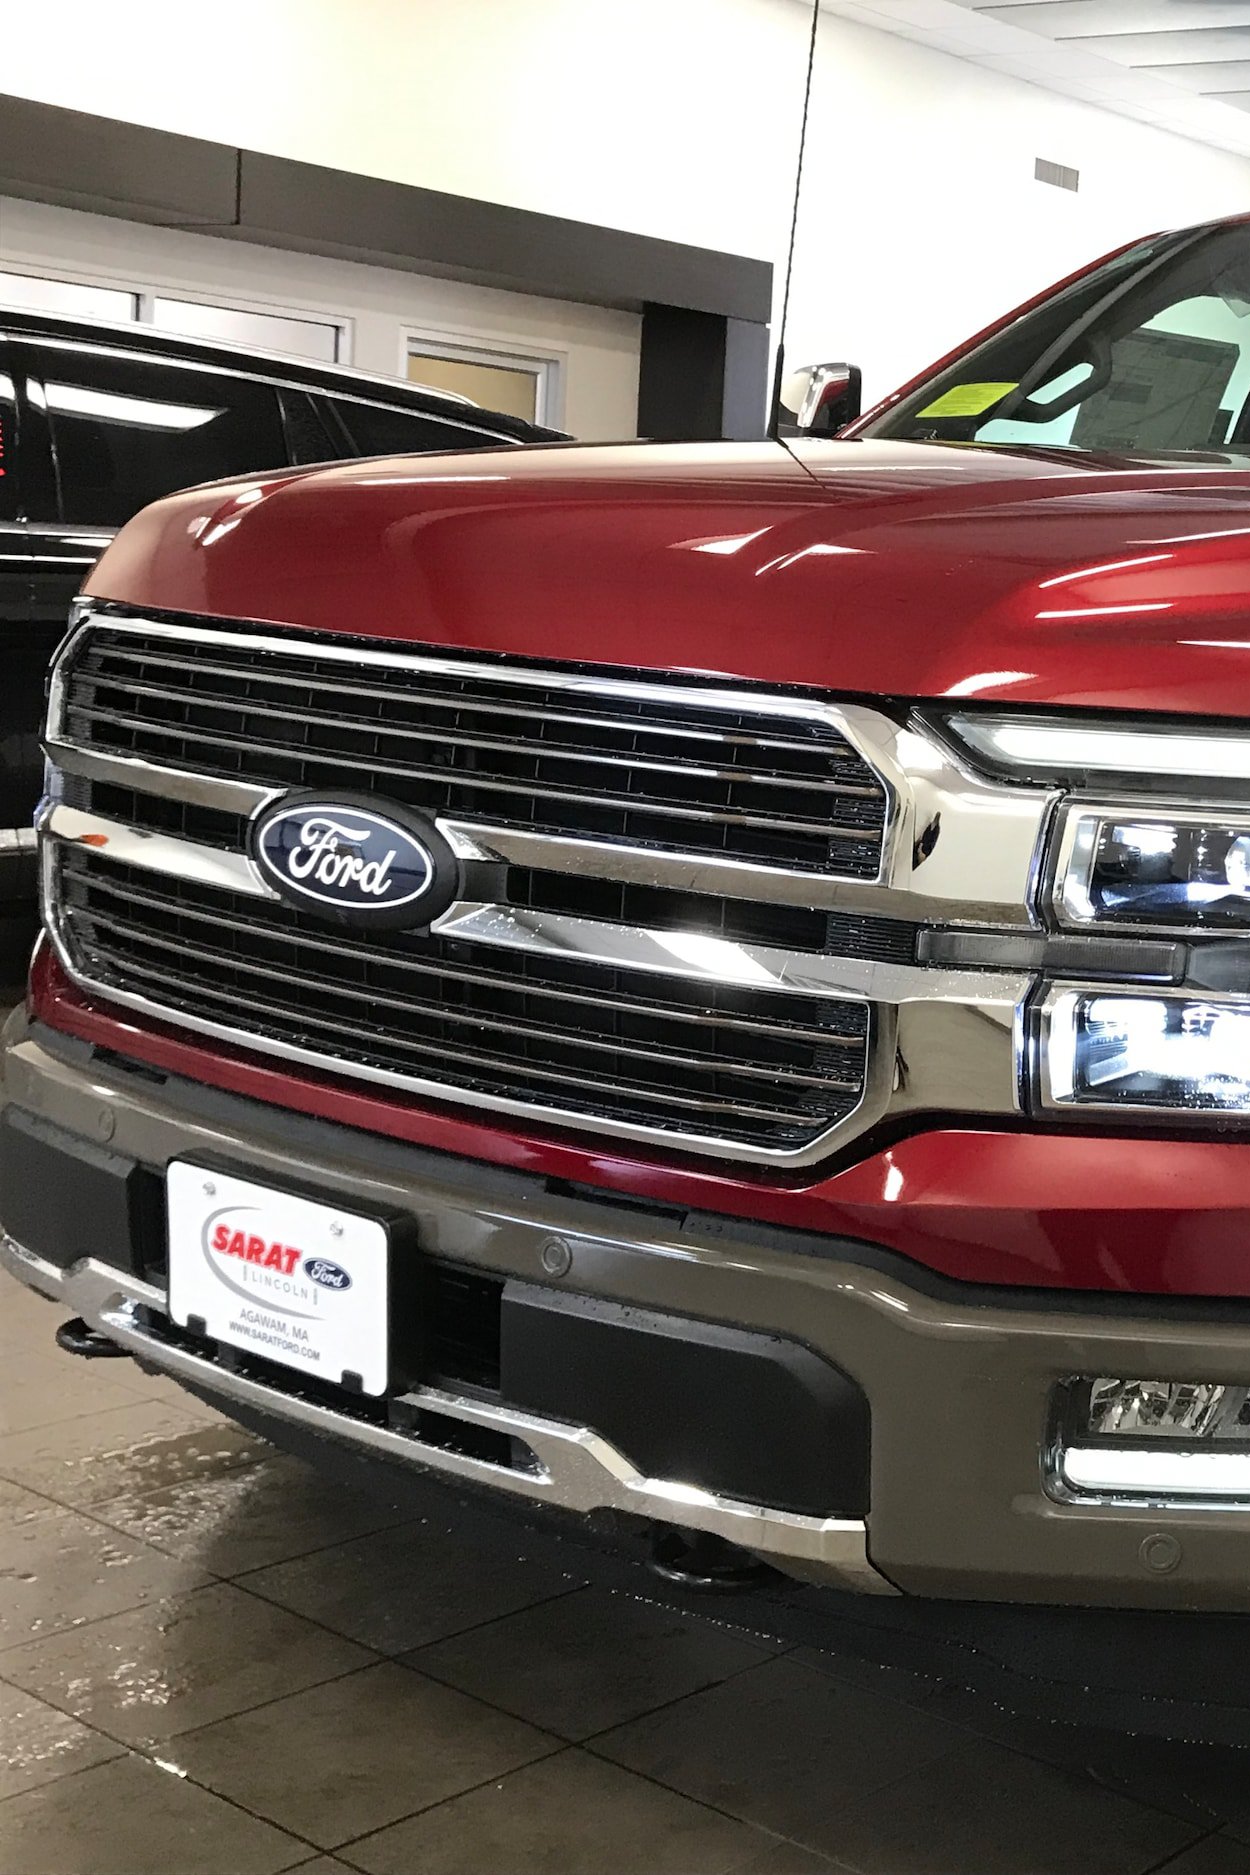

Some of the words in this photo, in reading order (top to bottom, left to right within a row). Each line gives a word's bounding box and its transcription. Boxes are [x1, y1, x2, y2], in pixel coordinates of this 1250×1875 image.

[288, 817, 397, 896] Ford
[212, 1224, 302, 1276] SARAT
[252, 1273, 308, 1299] LINCOLN
[310, 1260, 344, 1289] Ford
[229, 1321, 320, 1361] WWW.SARATFORD.COM
[240, 1308, 290, 1337] AGAWAM,
[291, 1324, 310, 1343] MA
